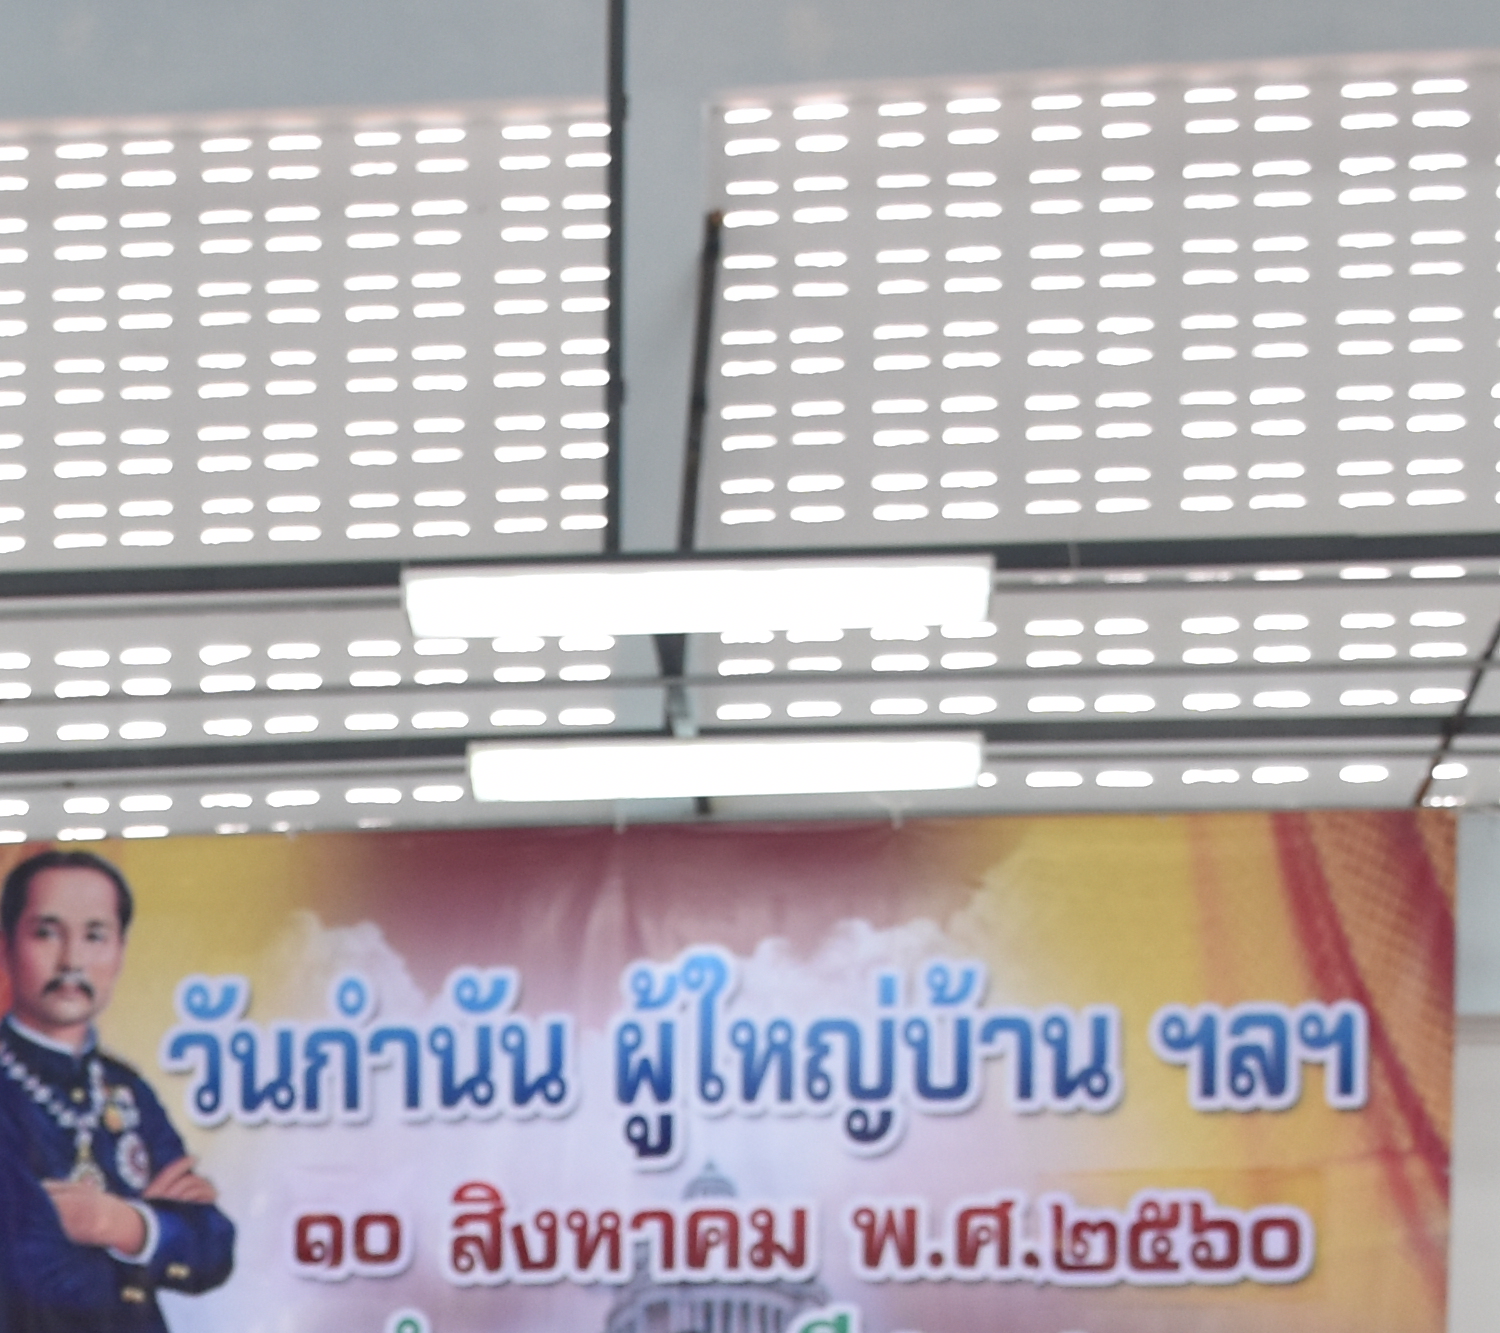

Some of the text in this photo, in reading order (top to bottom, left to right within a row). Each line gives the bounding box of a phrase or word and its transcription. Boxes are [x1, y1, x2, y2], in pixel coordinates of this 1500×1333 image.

[167, 952, 1358, 1158] วันกำนัน ผู้ใหญ่บ้าน ฯลฯ
[293, 1181, 1303, 1274] ๑๐ สิงหาคม พ.ศ.๒๕๖๐
